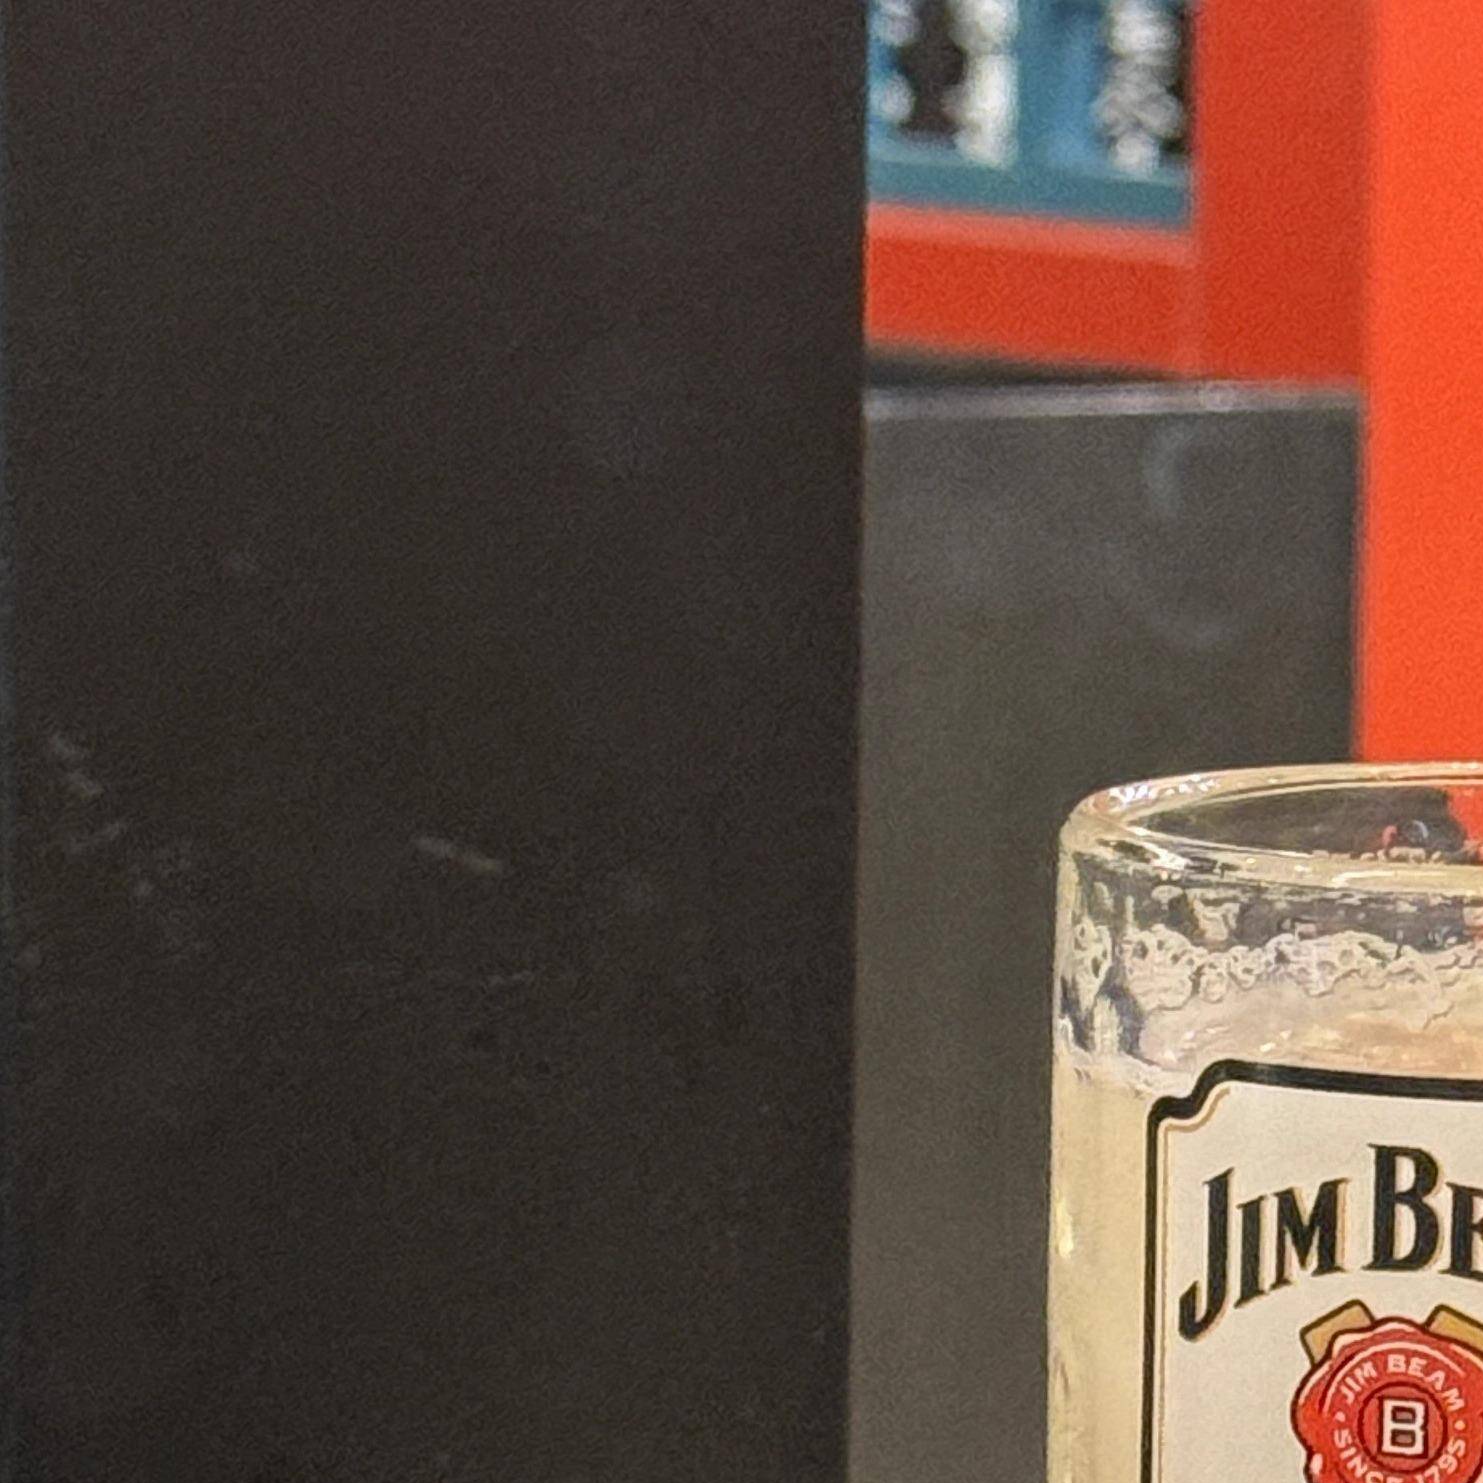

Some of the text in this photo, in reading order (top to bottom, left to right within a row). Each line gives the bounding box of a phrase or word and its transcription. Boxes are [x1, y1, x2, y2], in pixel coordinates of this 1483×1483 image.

[1178, 1167, 1350, 1341] JIM
[1337, 1353, 1466, 1411] JIM BEAM
[1380, 1397, 1429, 1459] B
